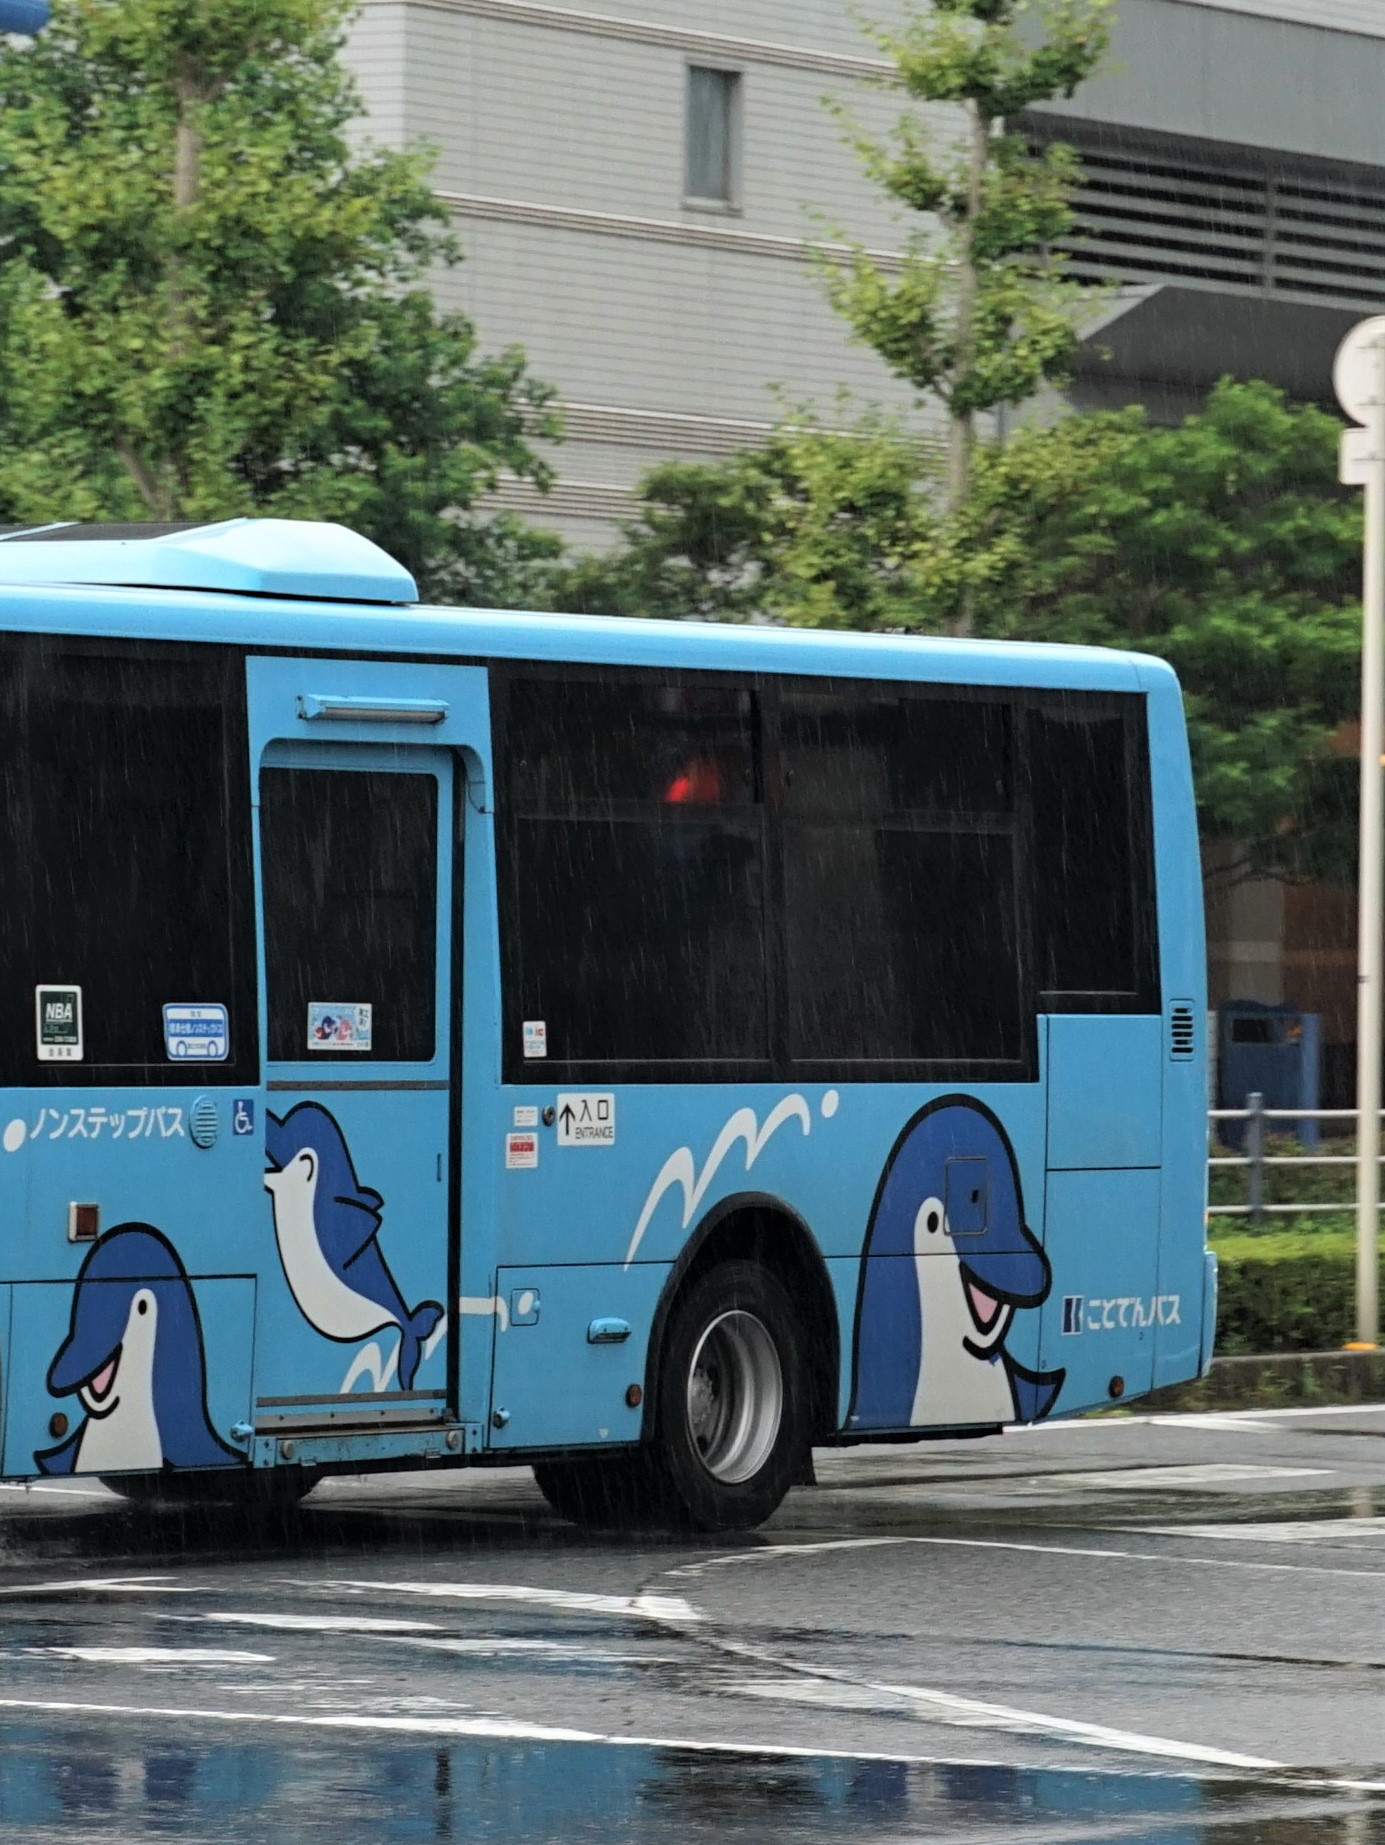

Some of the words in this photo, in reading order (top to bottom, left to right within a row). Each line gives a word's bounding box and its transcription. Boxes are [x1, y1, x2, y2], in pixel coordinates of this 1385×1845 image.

[45, 1002, 73, 1019] NBA
[579, 1099, 609, 1122] 入口
[30, 1105, 185, 1140] ノンステップバス
[575, 1126, 614, 1139] ENTRANCE
[1087, 1294, 1182, 1330] ことでんバス
